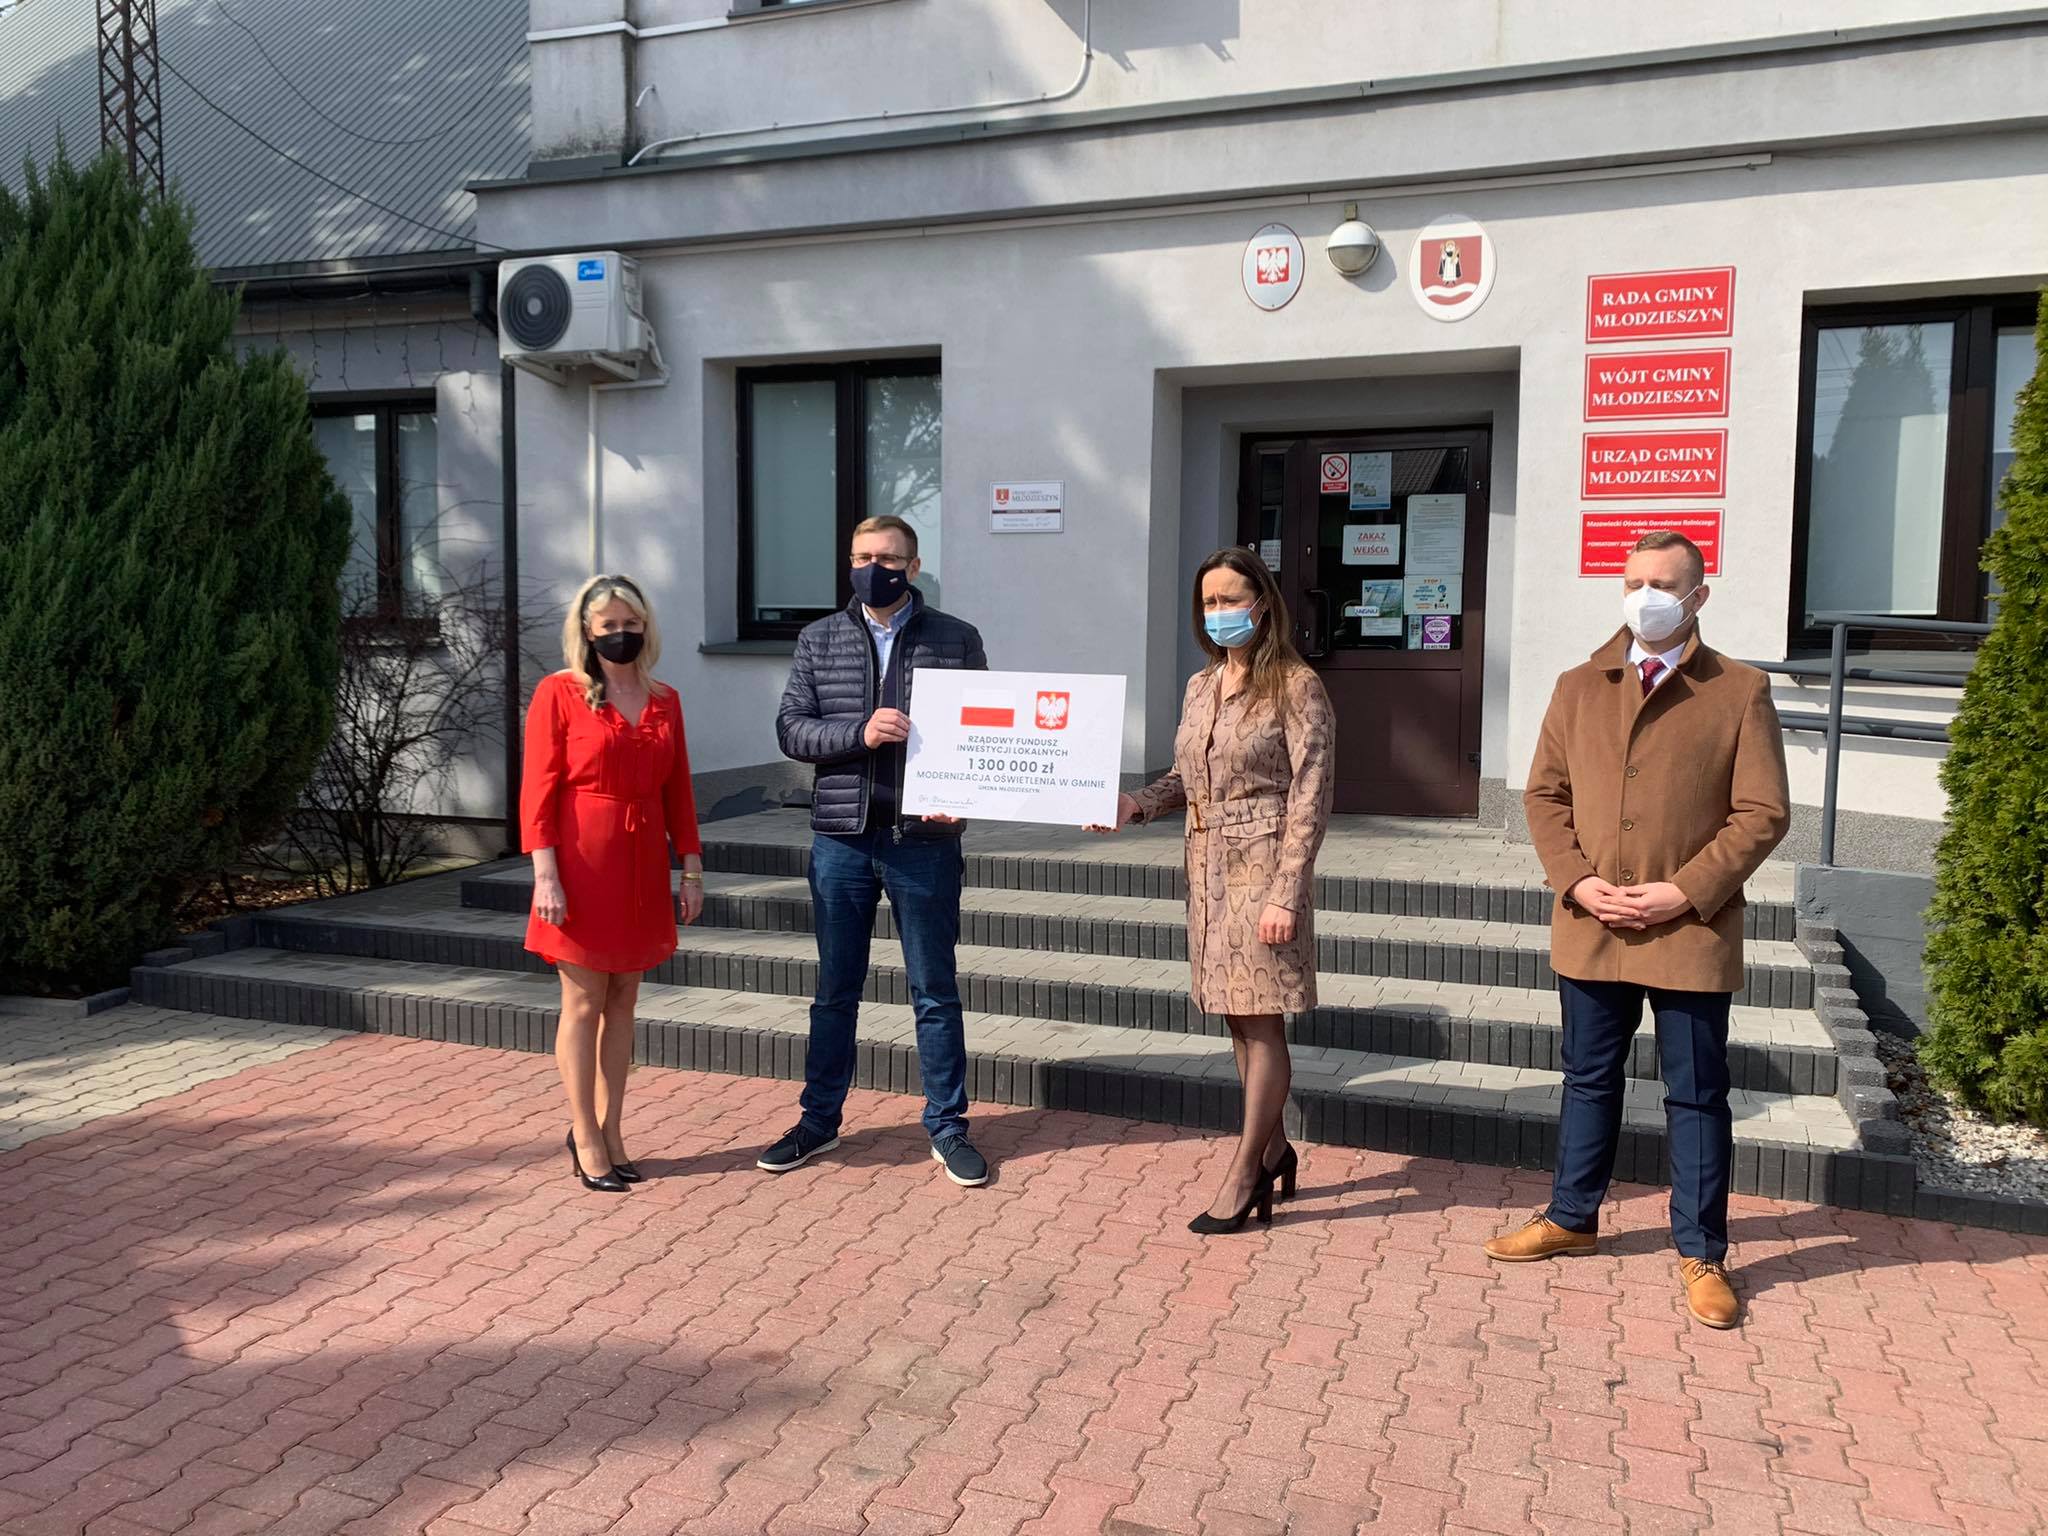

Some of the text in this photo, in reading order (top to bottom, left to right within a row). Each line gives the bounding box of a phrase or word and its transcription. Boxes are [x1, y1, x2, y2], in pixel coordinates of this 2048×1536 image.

[1602, 286, 1718, 306] RADA GMINY
[1594, 307, 1724, 328] MŁODZIESZYN
[1600, 367, 1714, 384] WÓJT GMINY
[1592, 388, 1720, 406] MŁODZIESZYN
[1591, 447, 1717, 465] URZĄD GMINY
[1589, 468, 1717, 484] MŁODZIESZYN
[1358, 532, 1385, 540] ZAKAZ
[1353, 545, 1389, 553] WEJŚCIA
[968, 735, 1058, 747] RZĄDOWY FUNDUSZ
[957, 744, 1068, 757] INWESTYCJI LOKALNYCH
[968, 758, 1054, 774] 1 300 000 zł
[917, 771, 1106, 788] MODERNIZACJA OŚWIETLENIA W GMINIE
